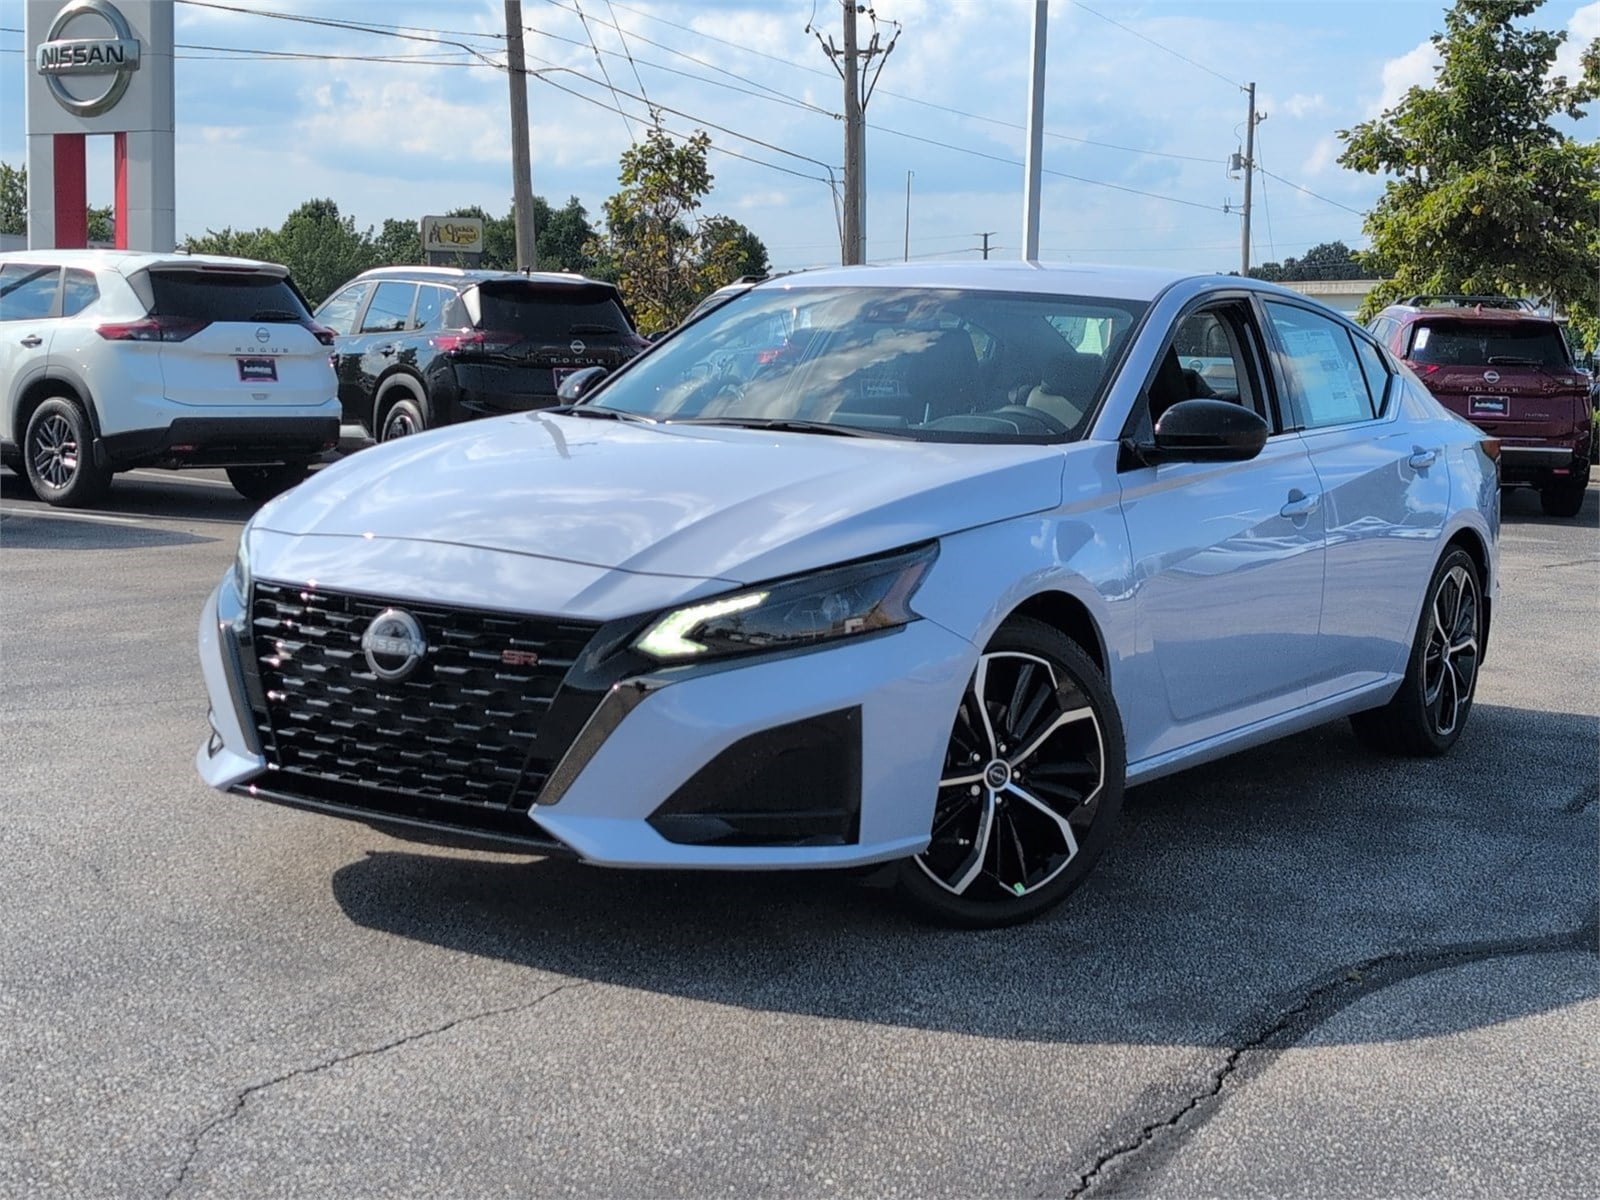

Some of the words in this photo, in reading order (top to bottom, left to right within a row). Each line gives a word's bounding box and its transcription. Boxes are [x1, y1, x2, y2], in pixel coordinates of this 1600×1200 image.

[41, 45, 123, 67] NISSAN
[362, 634, 426, 656] NISSAN
[502, 649, 538, 666] SR
